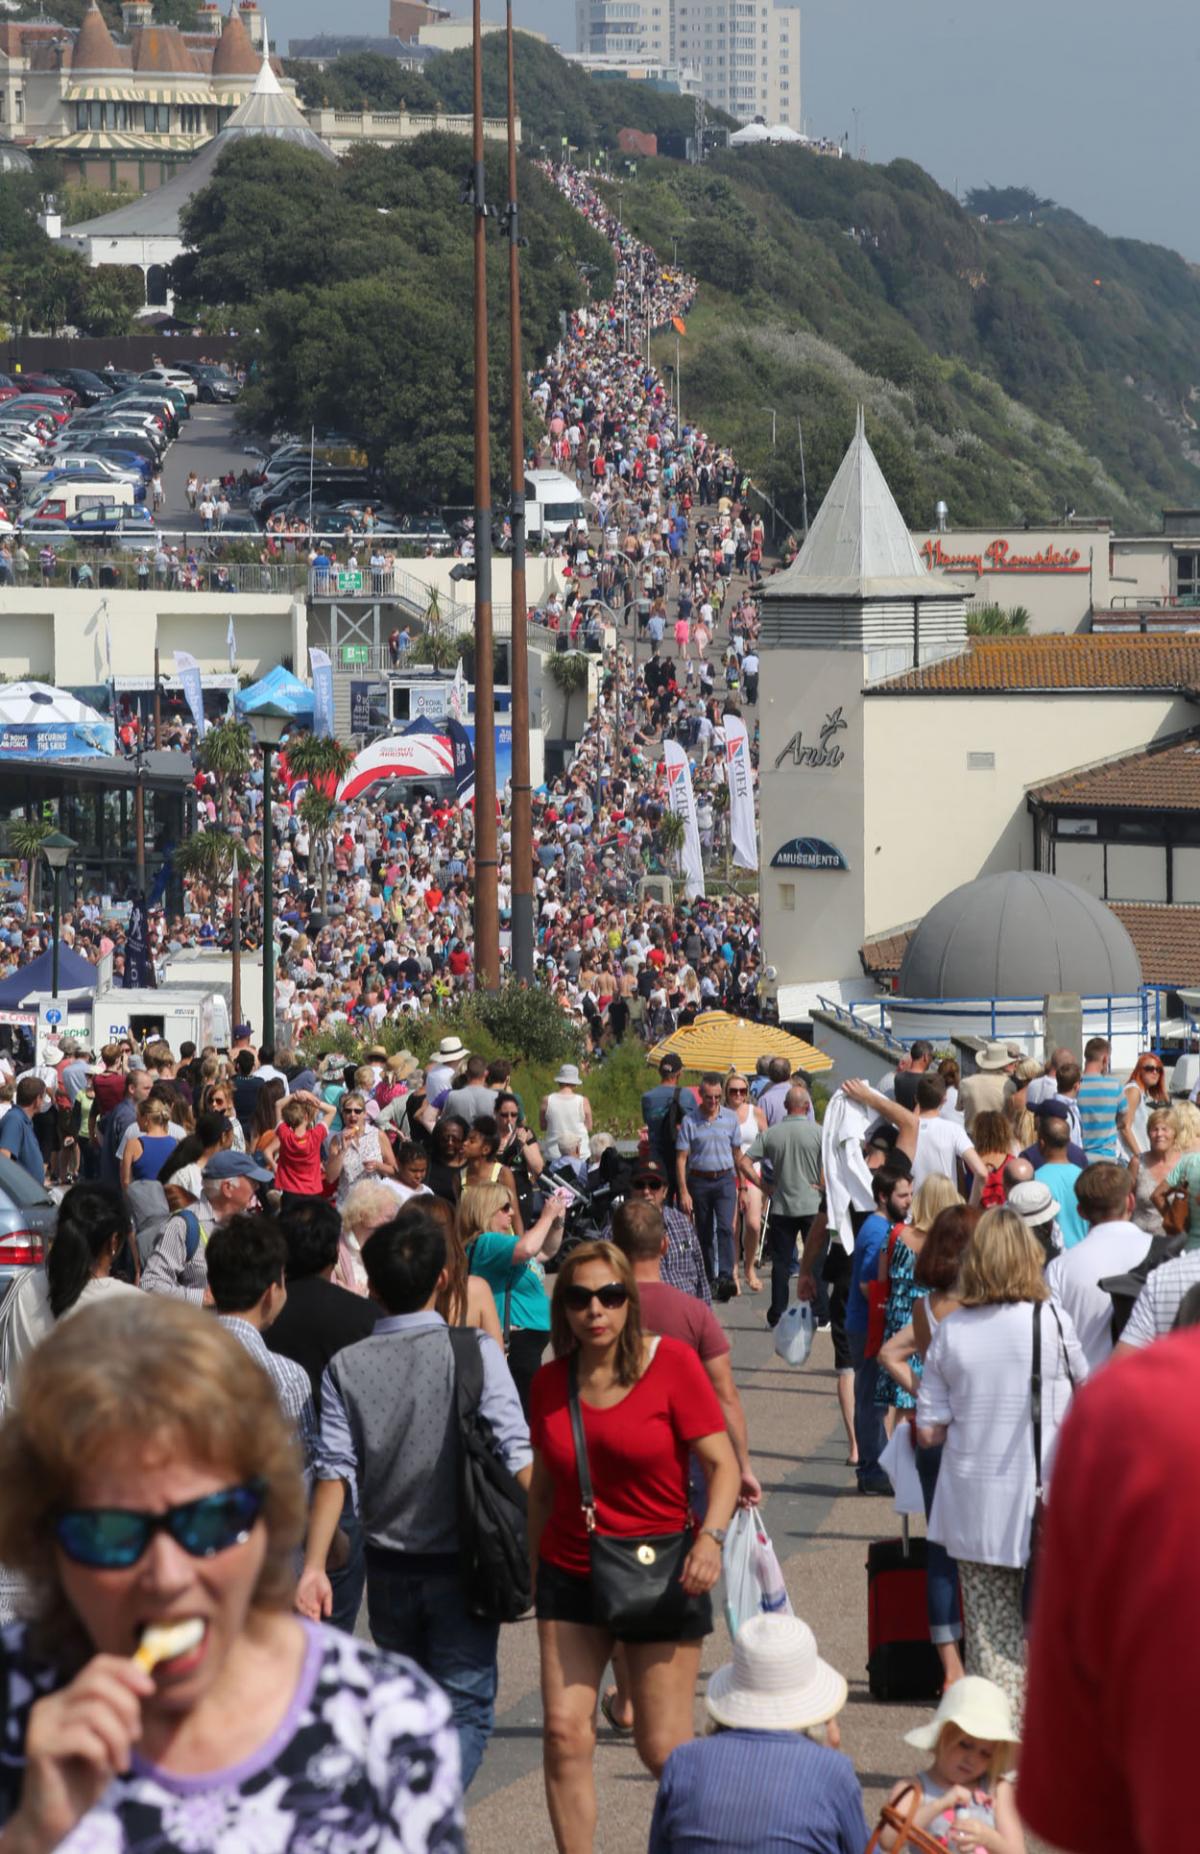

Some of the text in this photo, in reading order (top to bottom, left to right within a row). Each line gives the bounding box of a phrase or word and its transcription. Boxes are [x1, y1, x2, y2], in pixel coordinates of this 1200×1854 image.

[919, 538, 984, 577] Harry
[37, 732, 67, 741] SECURING
[775, 712, 847, 770] Aruba
[37, 741, 48, 750] THE
[776, 852, 840, 867] AMUSEMENTS
[64, 1027, 90, 1038] ECHO
